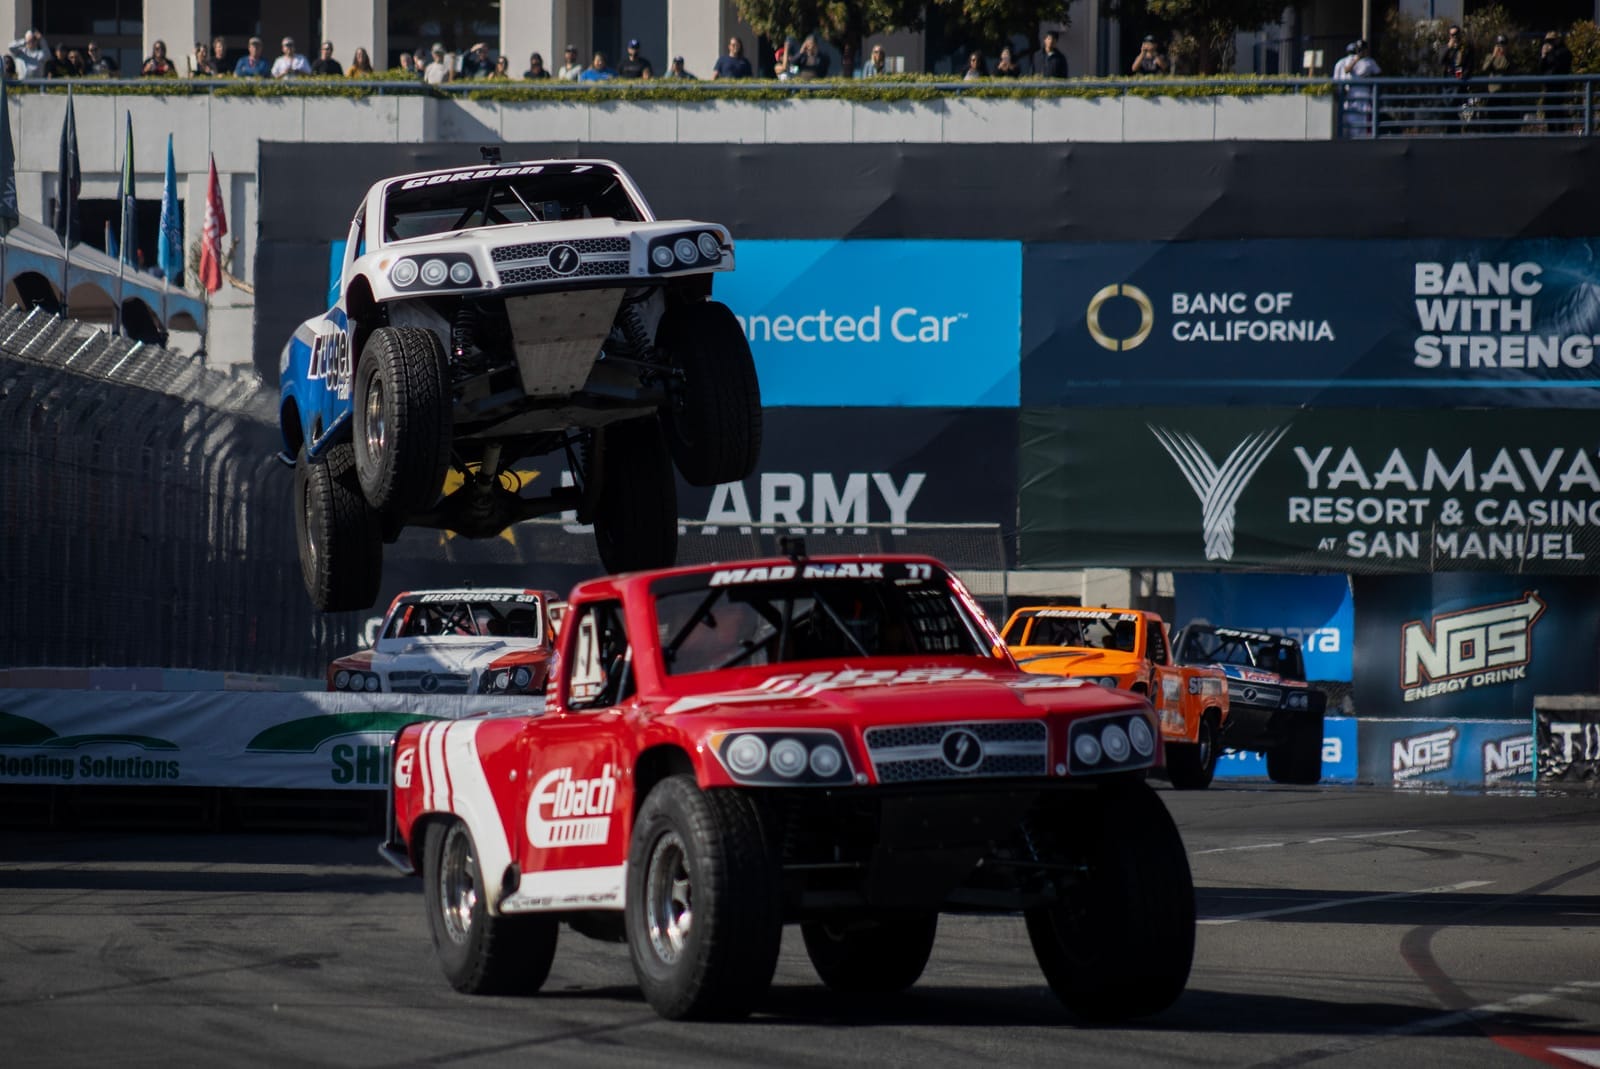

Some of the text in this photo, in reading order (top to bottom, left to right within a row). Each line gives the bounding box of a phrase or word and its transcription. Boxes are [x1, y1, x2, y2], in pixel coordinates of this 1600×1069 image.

[401, 164, 594, 190] GORDON 7
[1415, 262, 1543, 295] BANC
[1172, 292, 1293, 314] BANC OF
[1415, 299, 1532, 332] WITH
[738, 305, 881, 342] nected
[1172, 320, 1335, 342] CALIFORNIA
[701, 472, 927, 535] ARMY
[1289, 497, 1430, 524] RESORT
[1440, 498, 1464, 525] &
[1318, 531, 1586, 560] AT SAN MANUEL
[709, 562, 932, 587] MAD MAX 77
[1402, 592, 1545, 689] NOS
[1404, 665, 1527, 702] ENERGY DRINK
[79, 755, 180, 780] Solutions
[1393, 728, 1457, 774] NOS
[526, 763, 617, 848] Eibach
